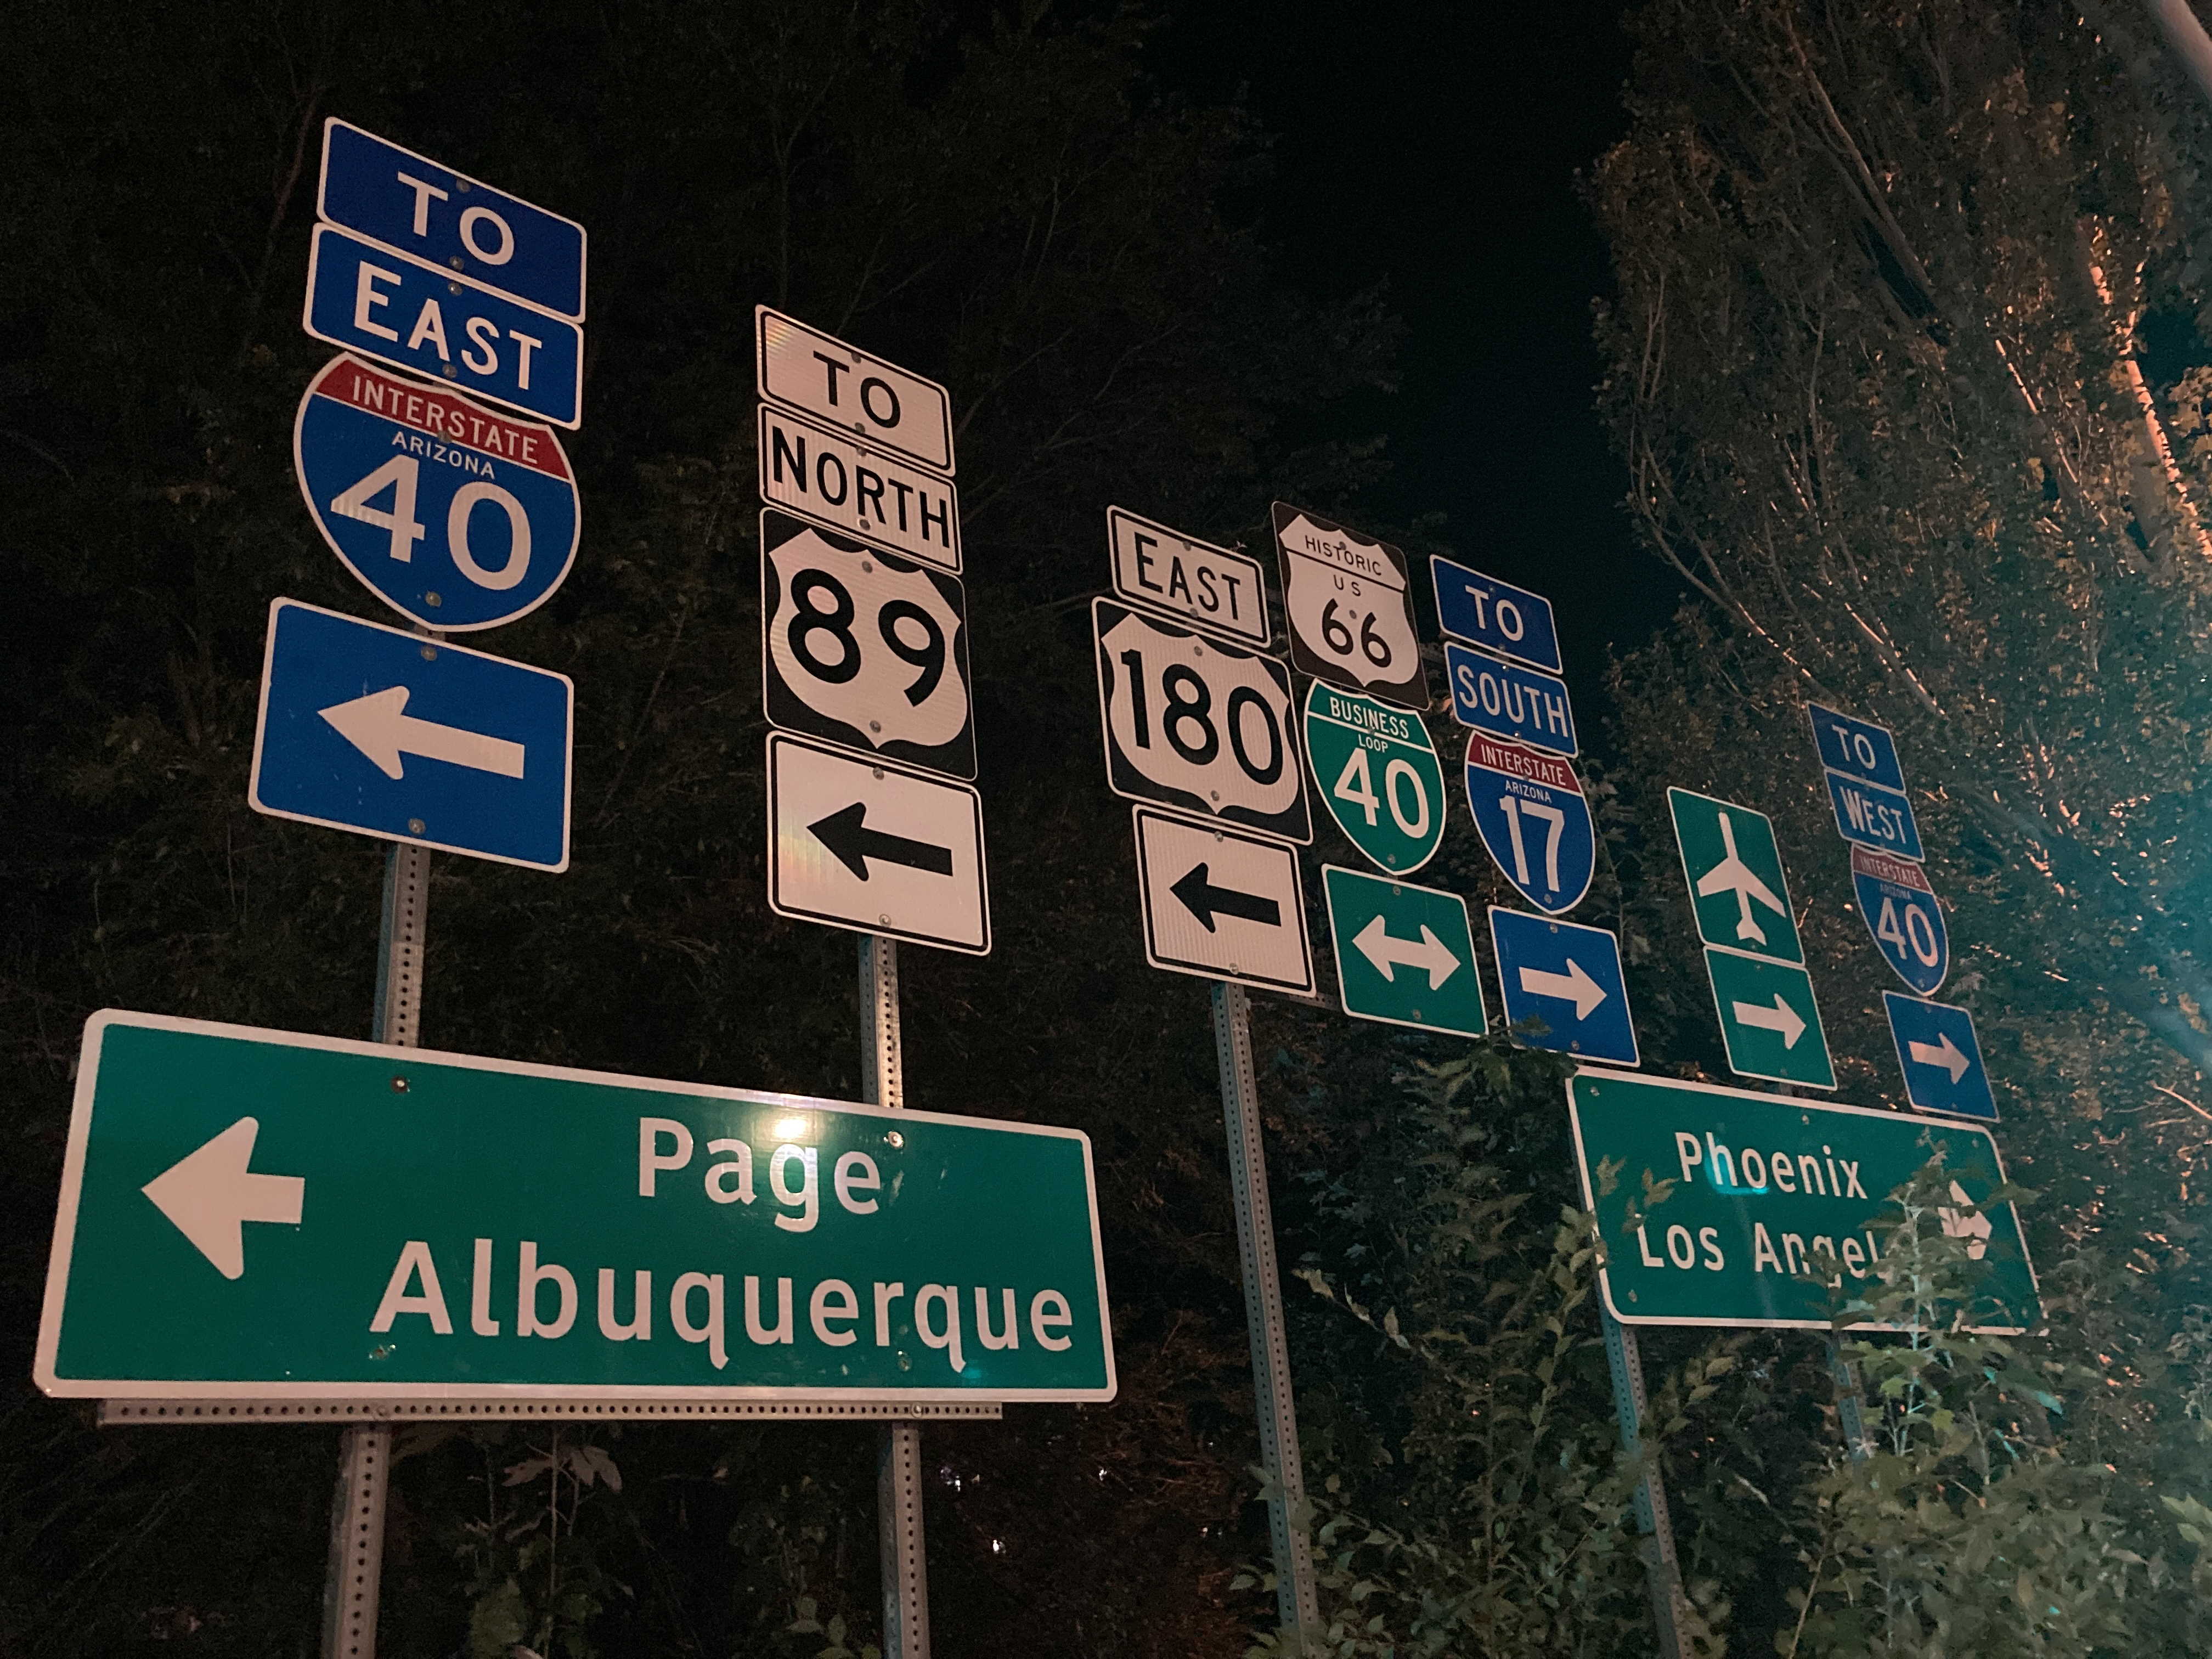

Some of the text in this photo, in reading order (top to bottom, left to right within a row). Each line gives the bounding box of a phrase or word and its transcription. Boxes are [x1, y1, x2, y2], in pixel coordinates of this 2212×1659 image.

[398, 171, 515, 266] TO
[354, 260, 541, 390] EAST
[353, 376, 538, 465] INTERSTATE
[813, 351, 901, 428] TO
[392, 431, 495, 479] ARIZONA
[772, 426, 950, 548] NORTH
[331, 454, 531, 590] 40
[1305, 535, 1381, 575] HISTORIC
[1134, 532, 1240, 620] EAST
[787, 568, 945, 707] 89
[1322, 598, 1392, 668] 66
[1465, 585, 1523, 641] TO
[1120, 648, 1283, 785] 180
[1329, 696, 1409, 739] BUSINESS
[1457, 664, 1568, 737] SOUTH
[1358, 733, 1389, 753] LOOP
[1481, 744, 1566, 786] INTERSTATE
[1832, 724, 1876, 769] TO
[1334, 747, 1429, 838] 40
[1505, 780, 1552, 803] ARIZONA
[1839, 786, 1906, 844] WEST
[1499, 795, 1565, 892] 17
[1860, 856, 1920, 887] INTERSTATE
[1878, 896, 1938, 967] 40
[637, 1117, 882, 1233] Page
[1674, 1132, 1868, 1199] Phoenix
[1635, 1214, 1724, 1271] Los
[369, 1238, 1073, 1372] Albuquerque
